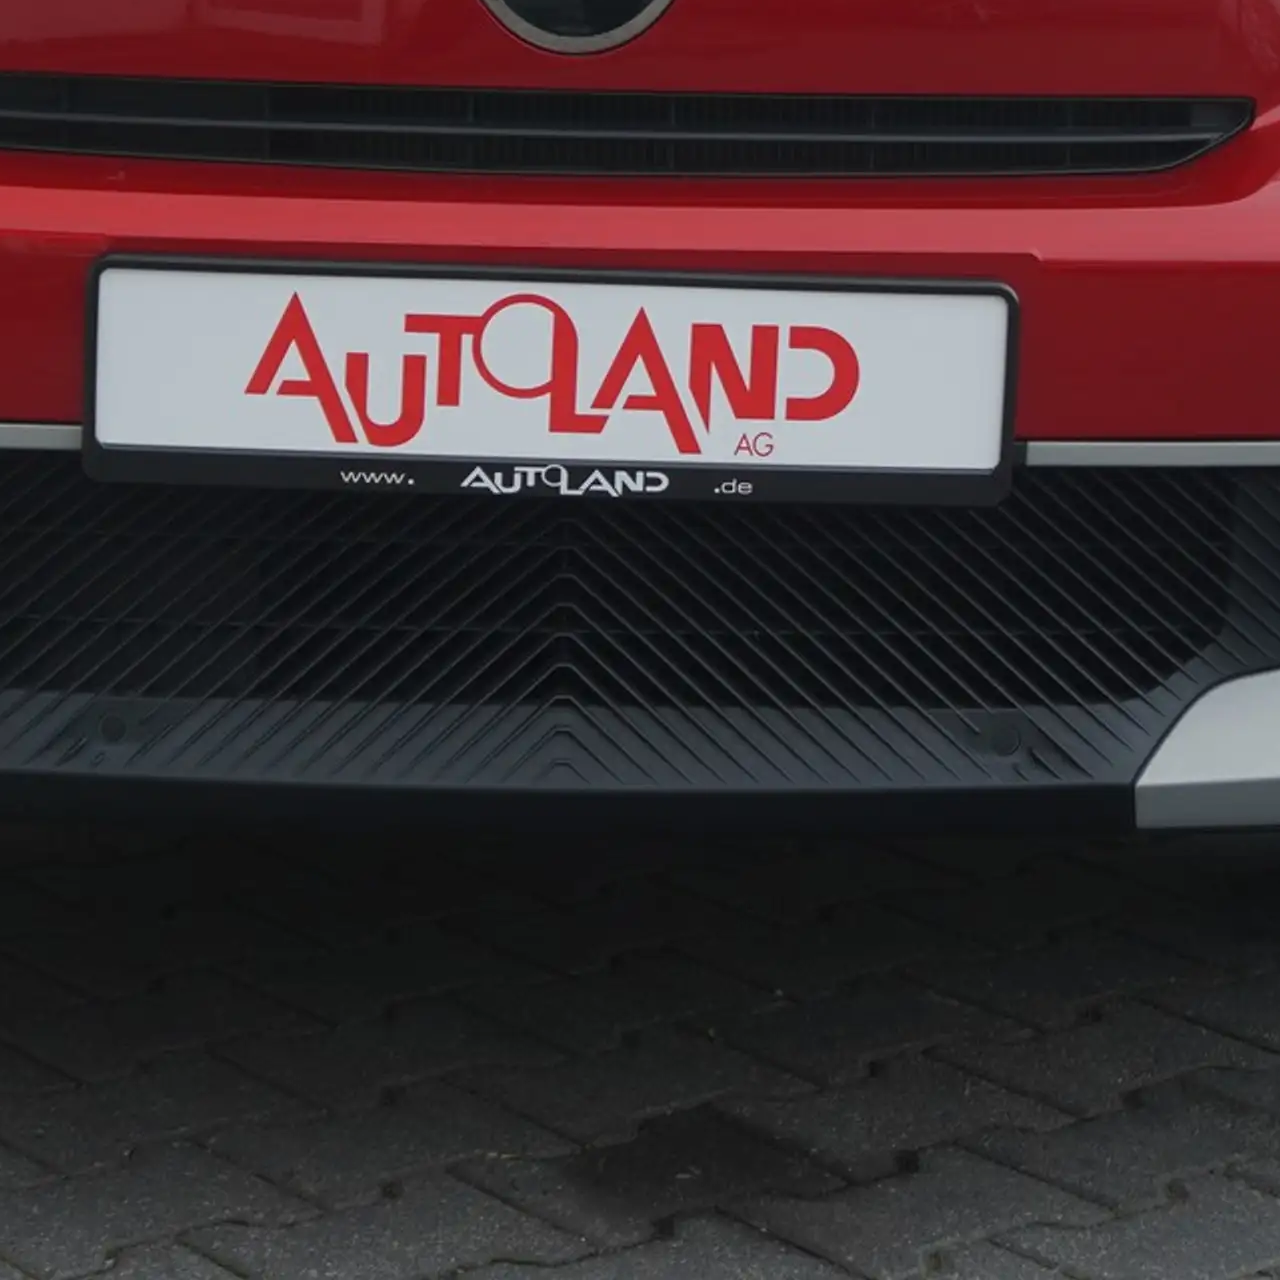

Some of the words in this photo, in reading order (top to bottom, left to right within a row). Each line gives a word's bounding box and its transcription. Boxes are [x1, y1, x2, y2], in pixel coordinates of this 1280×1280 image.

[244, 291, 861, 455] AUTOLAND
[733, 432, 775, 458] AG
[340, 470, 415, 486] www.
[460, 464, 670, 498] AUTOLAND
[713, 478, 753, 495] .de
